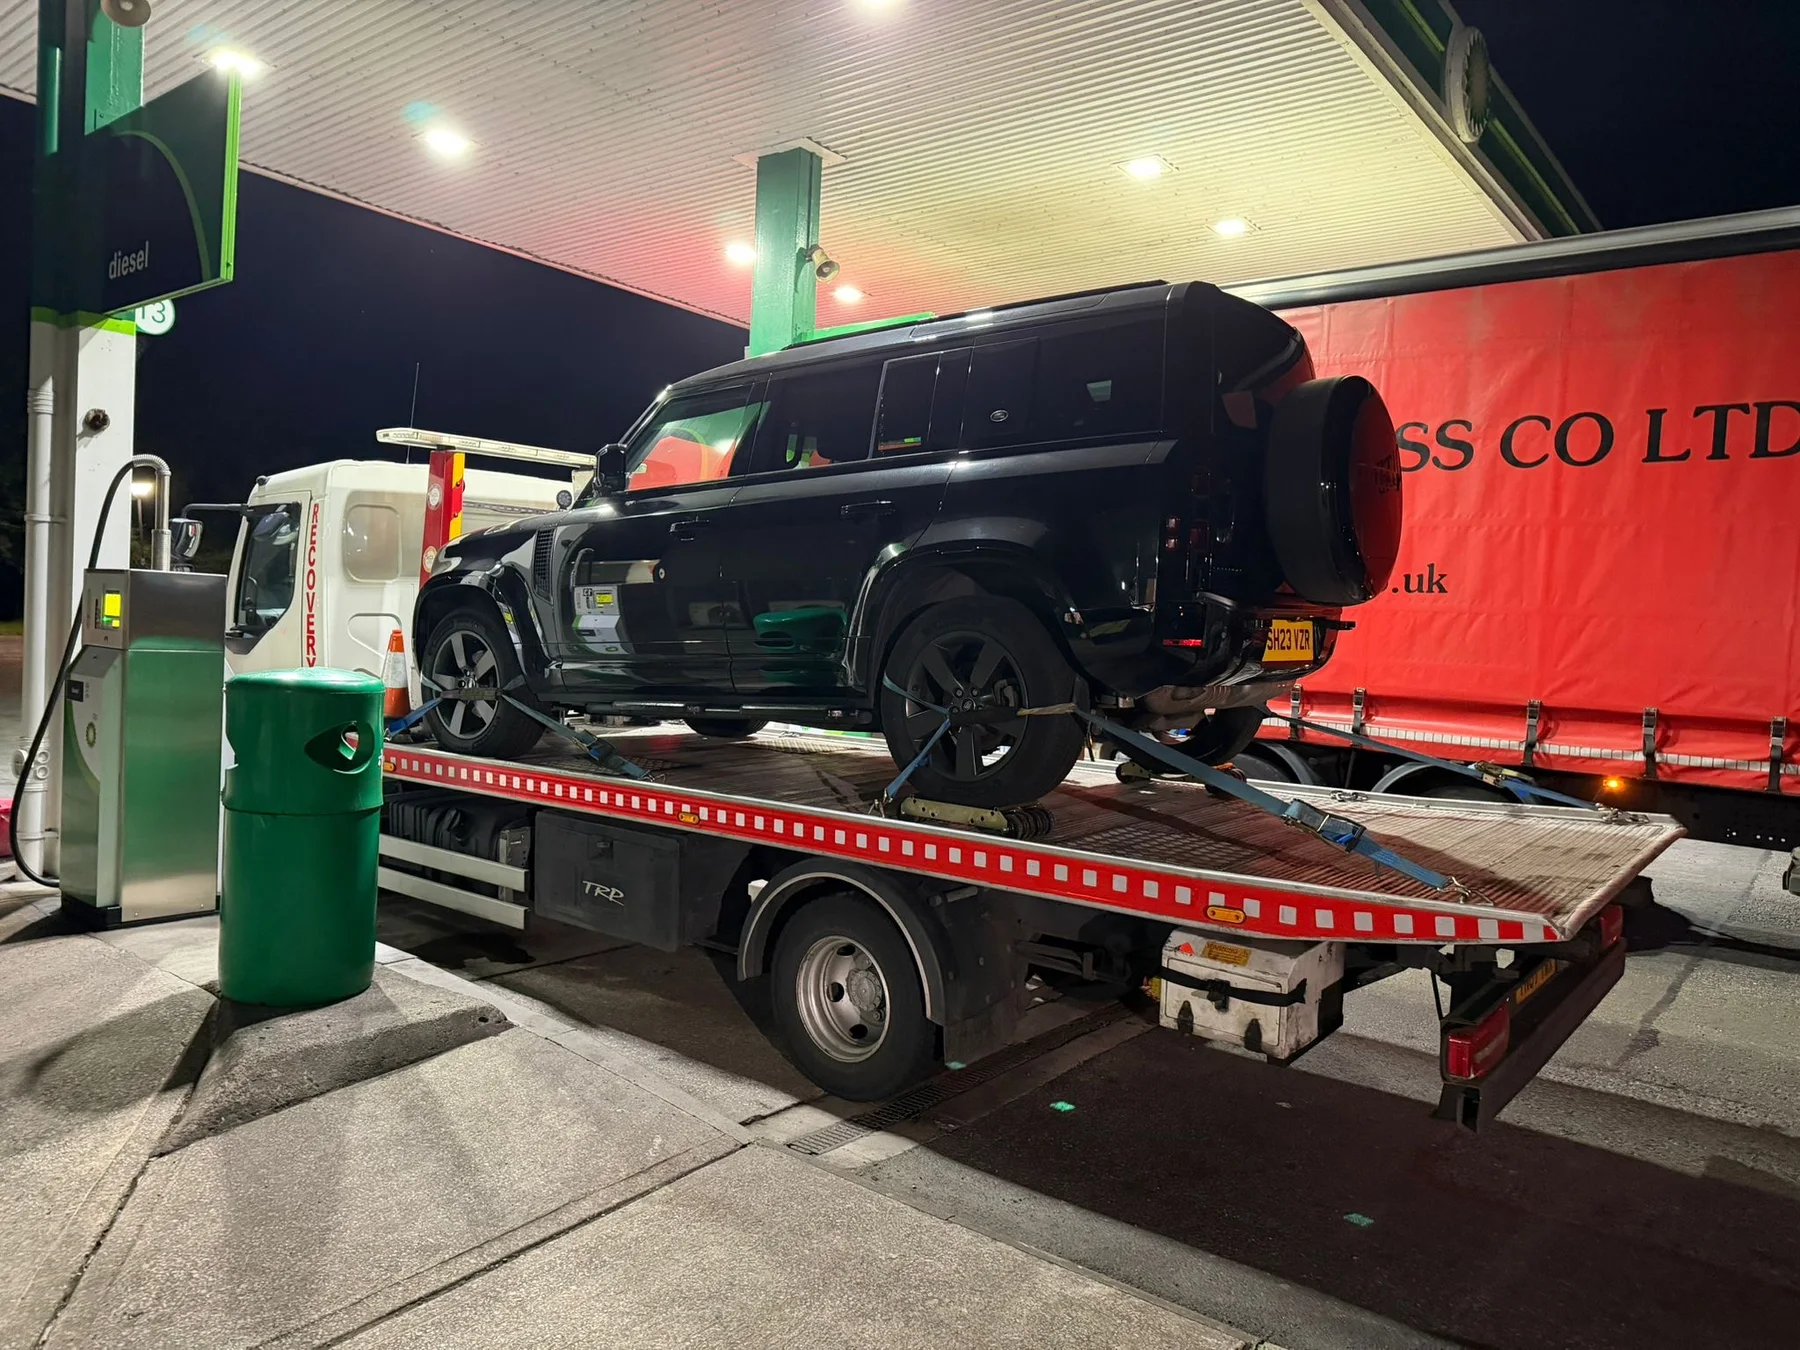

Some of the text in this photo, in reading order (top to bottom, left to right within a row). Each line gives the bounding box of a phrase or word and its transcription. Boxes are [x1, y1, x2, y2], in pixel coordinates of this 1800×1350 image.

[109, 240, 149, 279] diesel
[1500, 411, 1615, 469] CO
[1641, 400, 1800, 463] LTD
[1380, 562, 1448, 593] .uk
[1267, 628, 1311, 651] SH23 VZR
[582, 880, 625, 907] TRP
